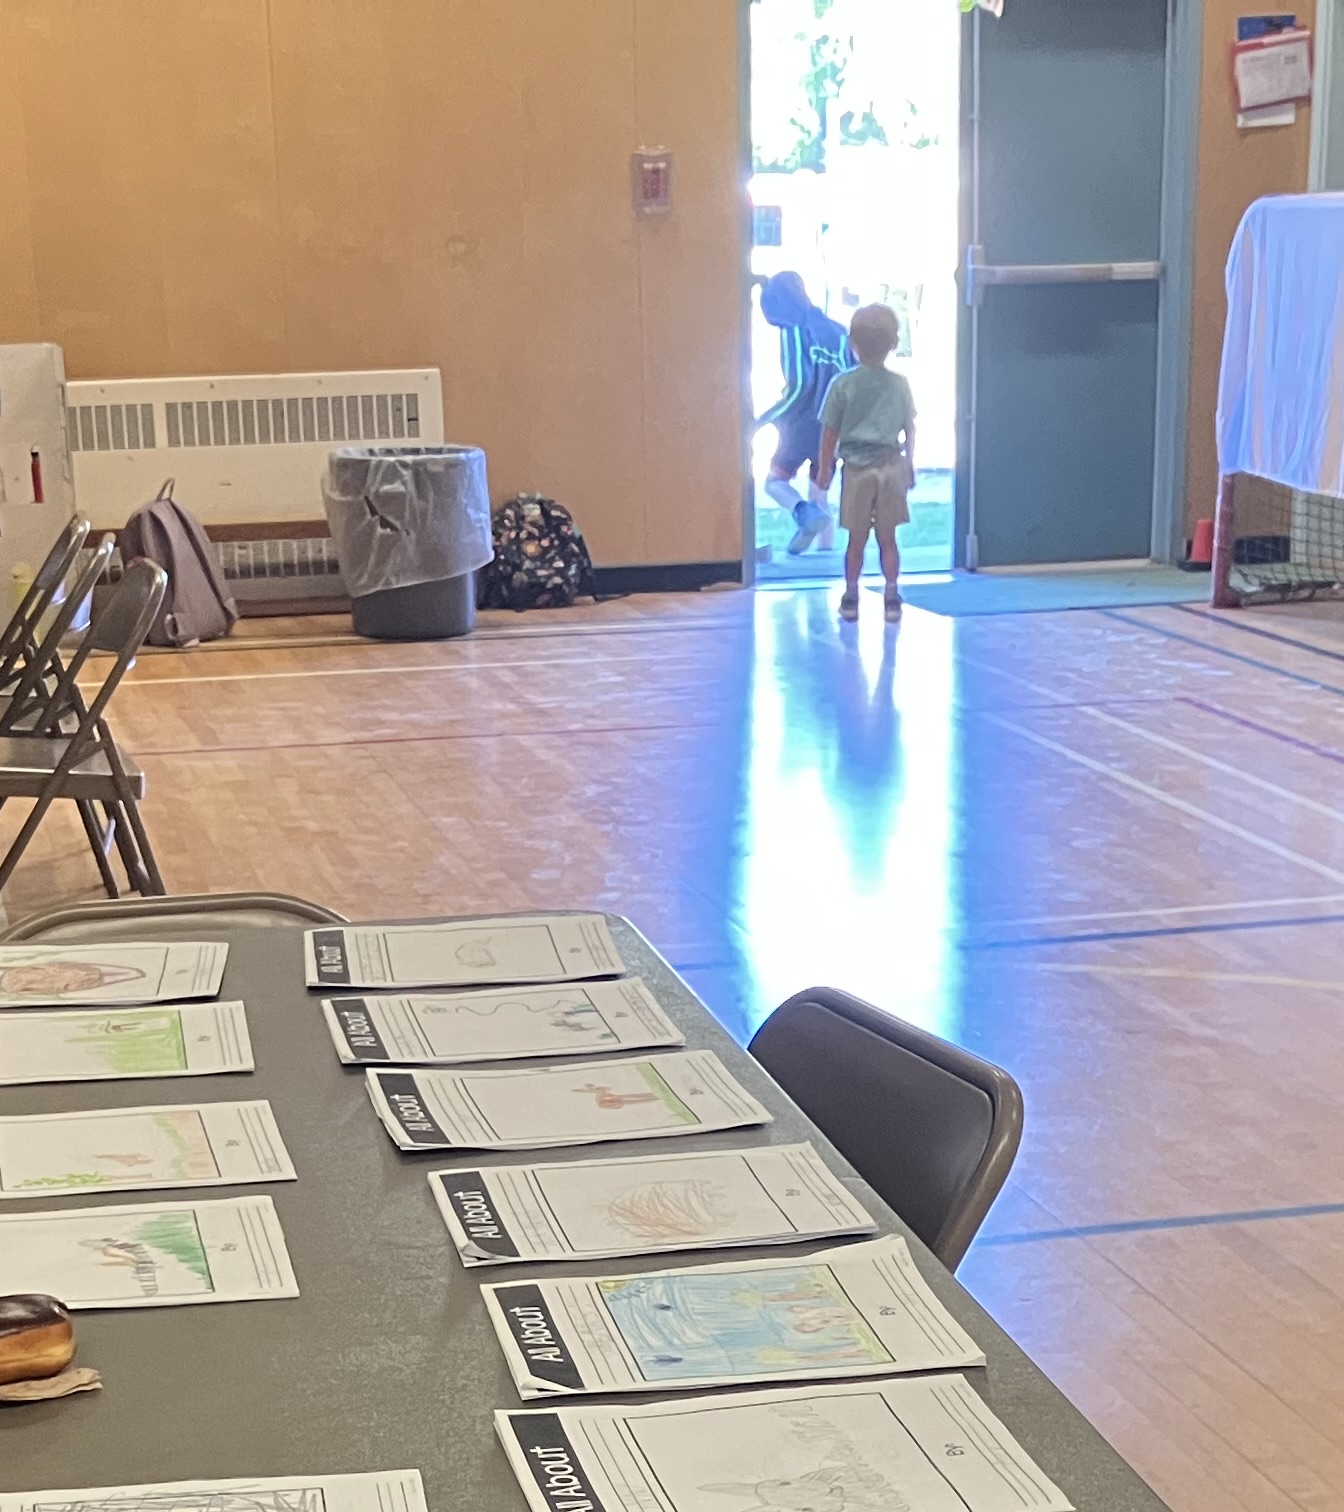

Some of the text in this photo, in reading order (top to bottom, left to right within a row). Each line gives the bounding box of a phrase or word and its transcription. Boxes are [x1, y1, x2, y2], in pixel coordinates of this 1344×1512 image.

[390, 1094, 435, 1132] All About
[453, 1191, 502, 1239] All About
[509, 1306, 564, 1363] All About
[529, 1446, 588, 1497] About
